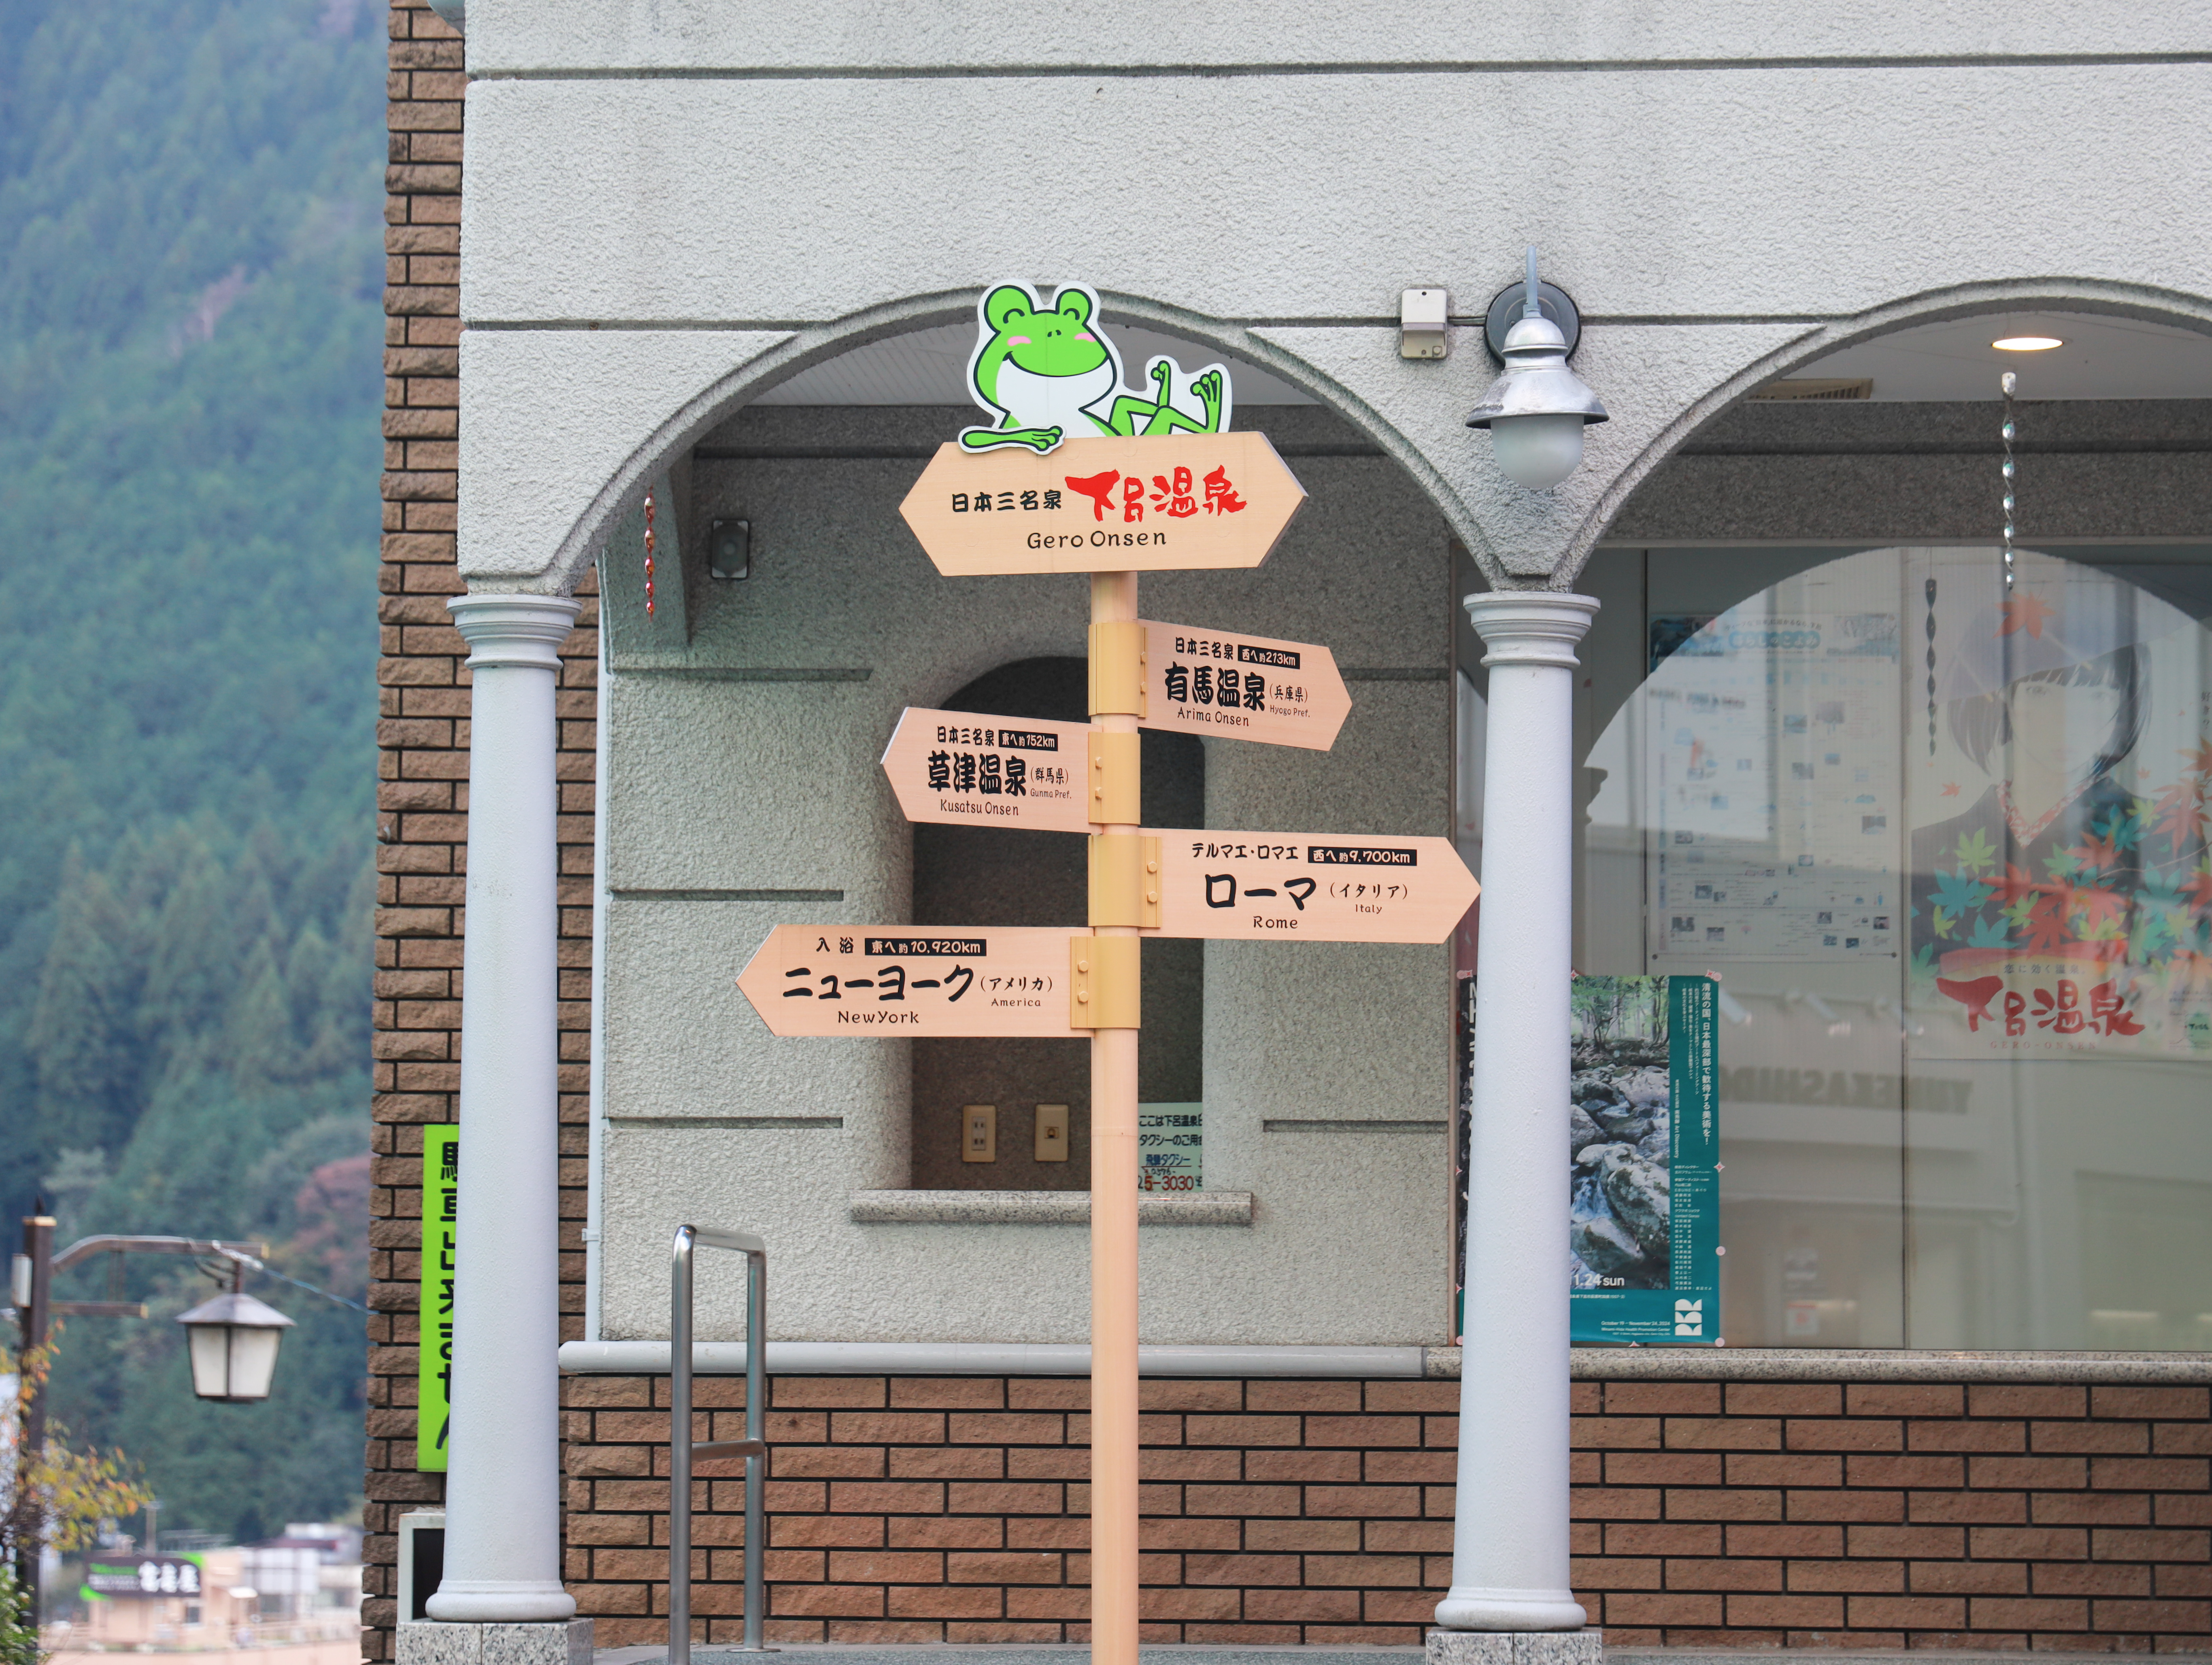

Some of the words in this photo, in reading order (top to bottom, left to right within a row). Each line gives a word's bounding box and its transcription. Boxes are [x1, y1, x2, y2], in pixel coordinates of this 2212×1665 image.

[952, 489, 1061, 512] 日本三名泉
[1065, 465, 1247, 522] 下呂温泉
[1027, 533, 1083, 549] Gero
[1091, 531, 1166, 546] Onsen
[1176, 637, 1233, 660] 日本三名泉
[1164, 661, 1266, 711] 有馬温泉
[1178, 707, 1210, 721] Arima
[1215, 711, 1249, 726] Onsen
[1270, 705, 1291, 716] Hyogo
[1294, 708, 1310, 717] Pref.
[938, 726, 994, 746] 日本三名泉
[928, 750, 1026, 797] 草津温泉
[941, 799, 982, 813] Kusatsu
[985, 802, 1018, 815] Onsen
[1031, 788, 1053, 797] Gunma
[1055, 790, 1071, 799] Pref.
[1192, 843, 1298, 859] テルマエ・ロマエ
[1205, 874, 1316, 910] ローマ
[1331, 883, 1407, 899] （イタリア）
[1254, 916, 1297, 929] Rome
[1356, 904, 1382, 914] Italy
[817, 937, 853, 953] 入浴
[783, 965, 973, 1002] ニューヨーク
[981, 976, 1052, 991] （アメリカ）
[1936, 975, 2145, 1037] 下呂温泉
[1570, 1273, 1602, 1286] 1.24
[1603, 1276, 1625, 1286] sun
